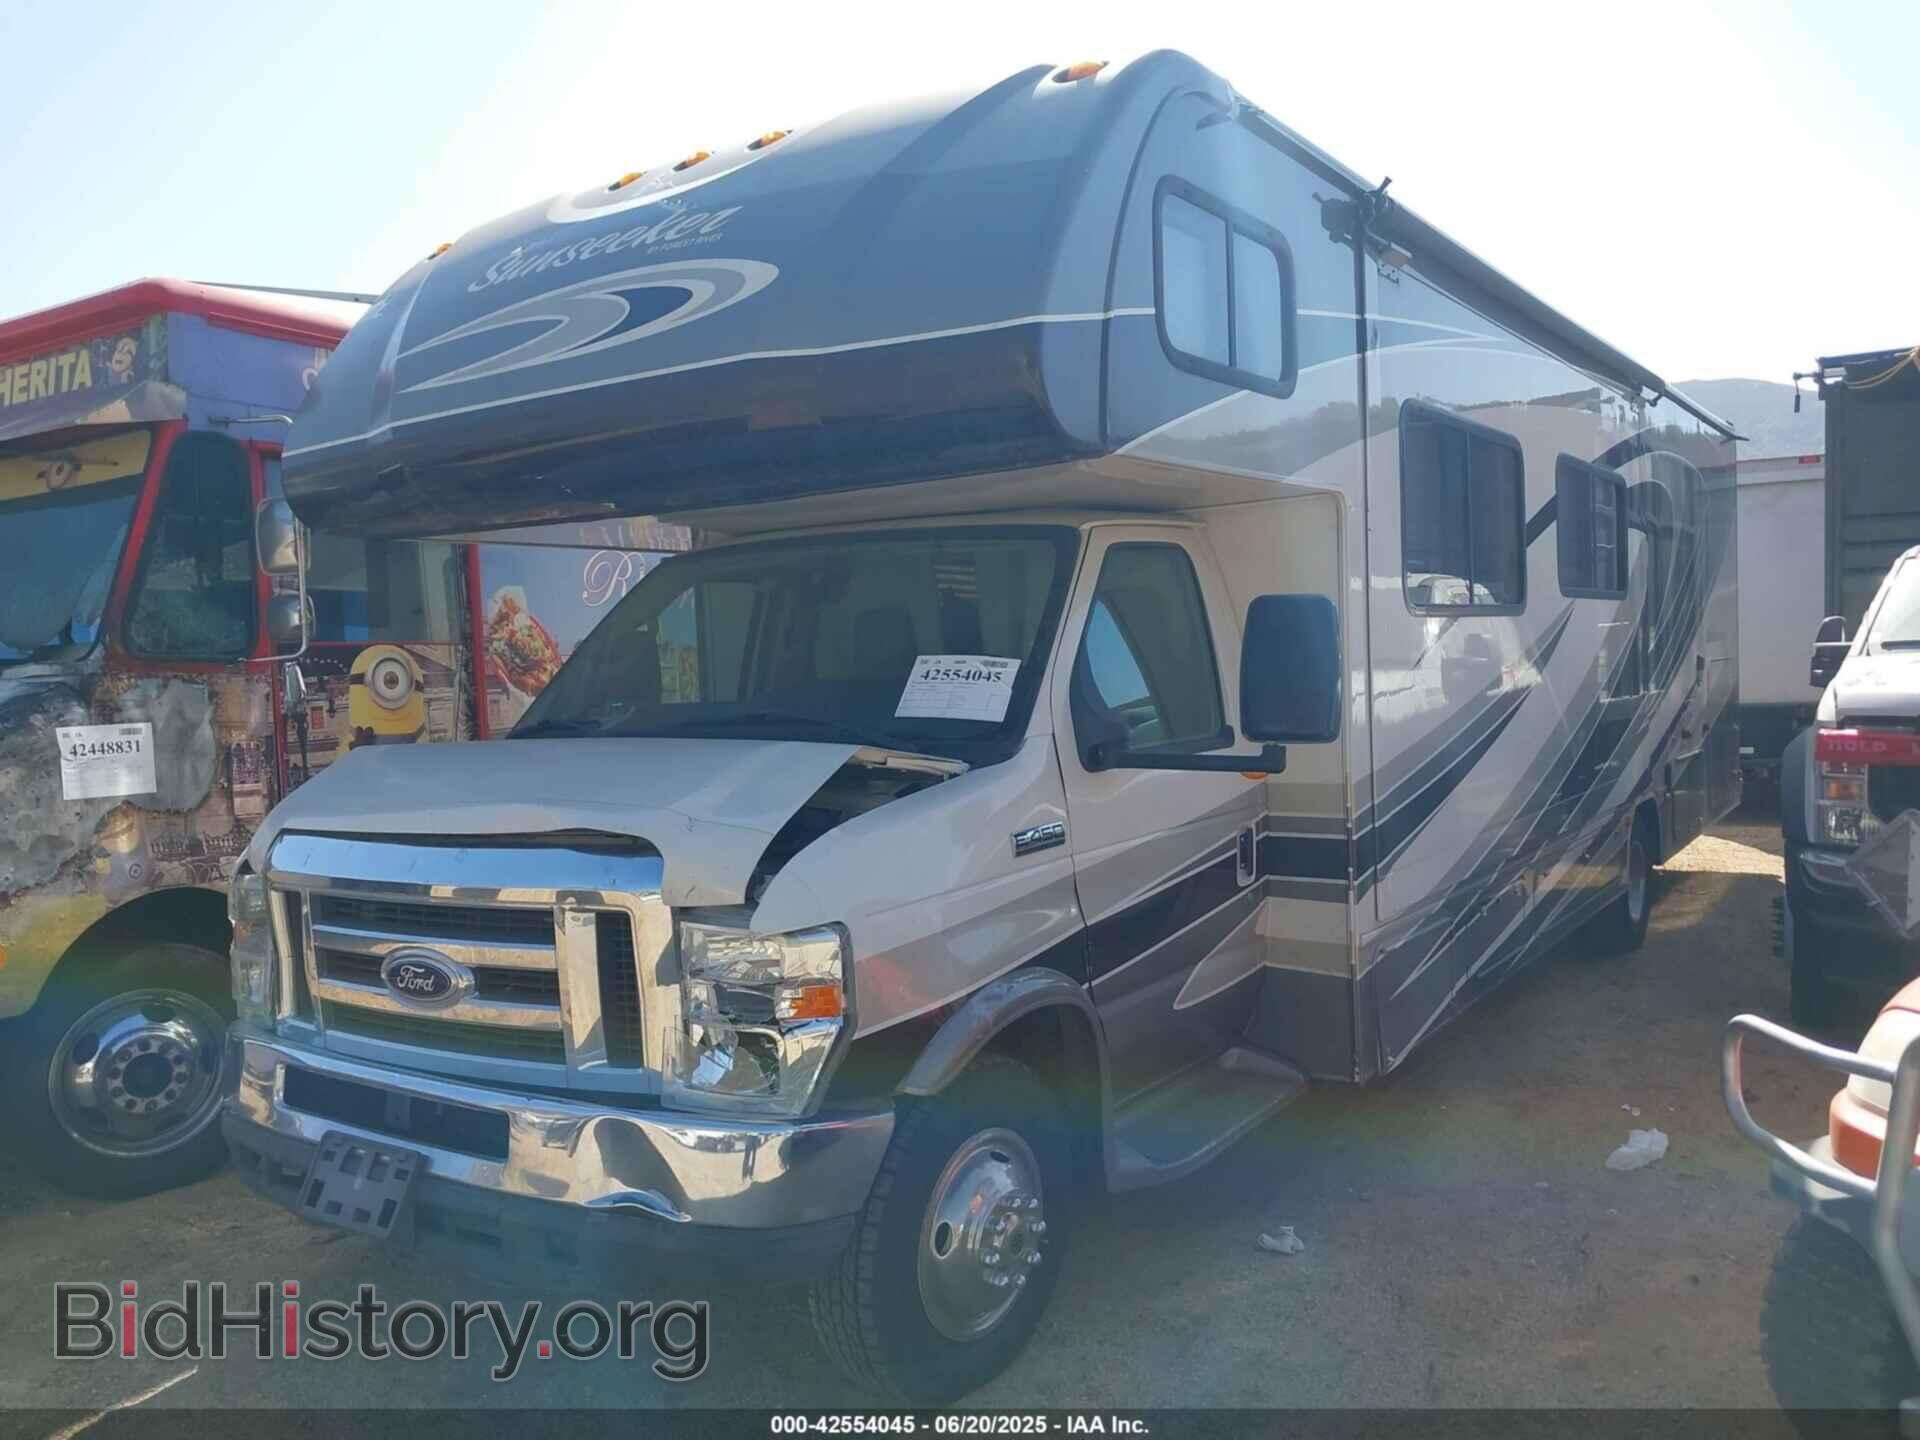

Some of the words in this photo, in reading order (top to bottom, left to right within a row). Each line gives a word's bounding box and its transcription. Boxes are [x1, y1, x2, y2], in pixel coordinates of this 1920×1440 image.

[467, 205, 744, 292] Sunseeker
[919, 669, 1003, 683] 42554045
[69, 740, 141, 757] 42448831
[396, 964, 435, 992] Ford
